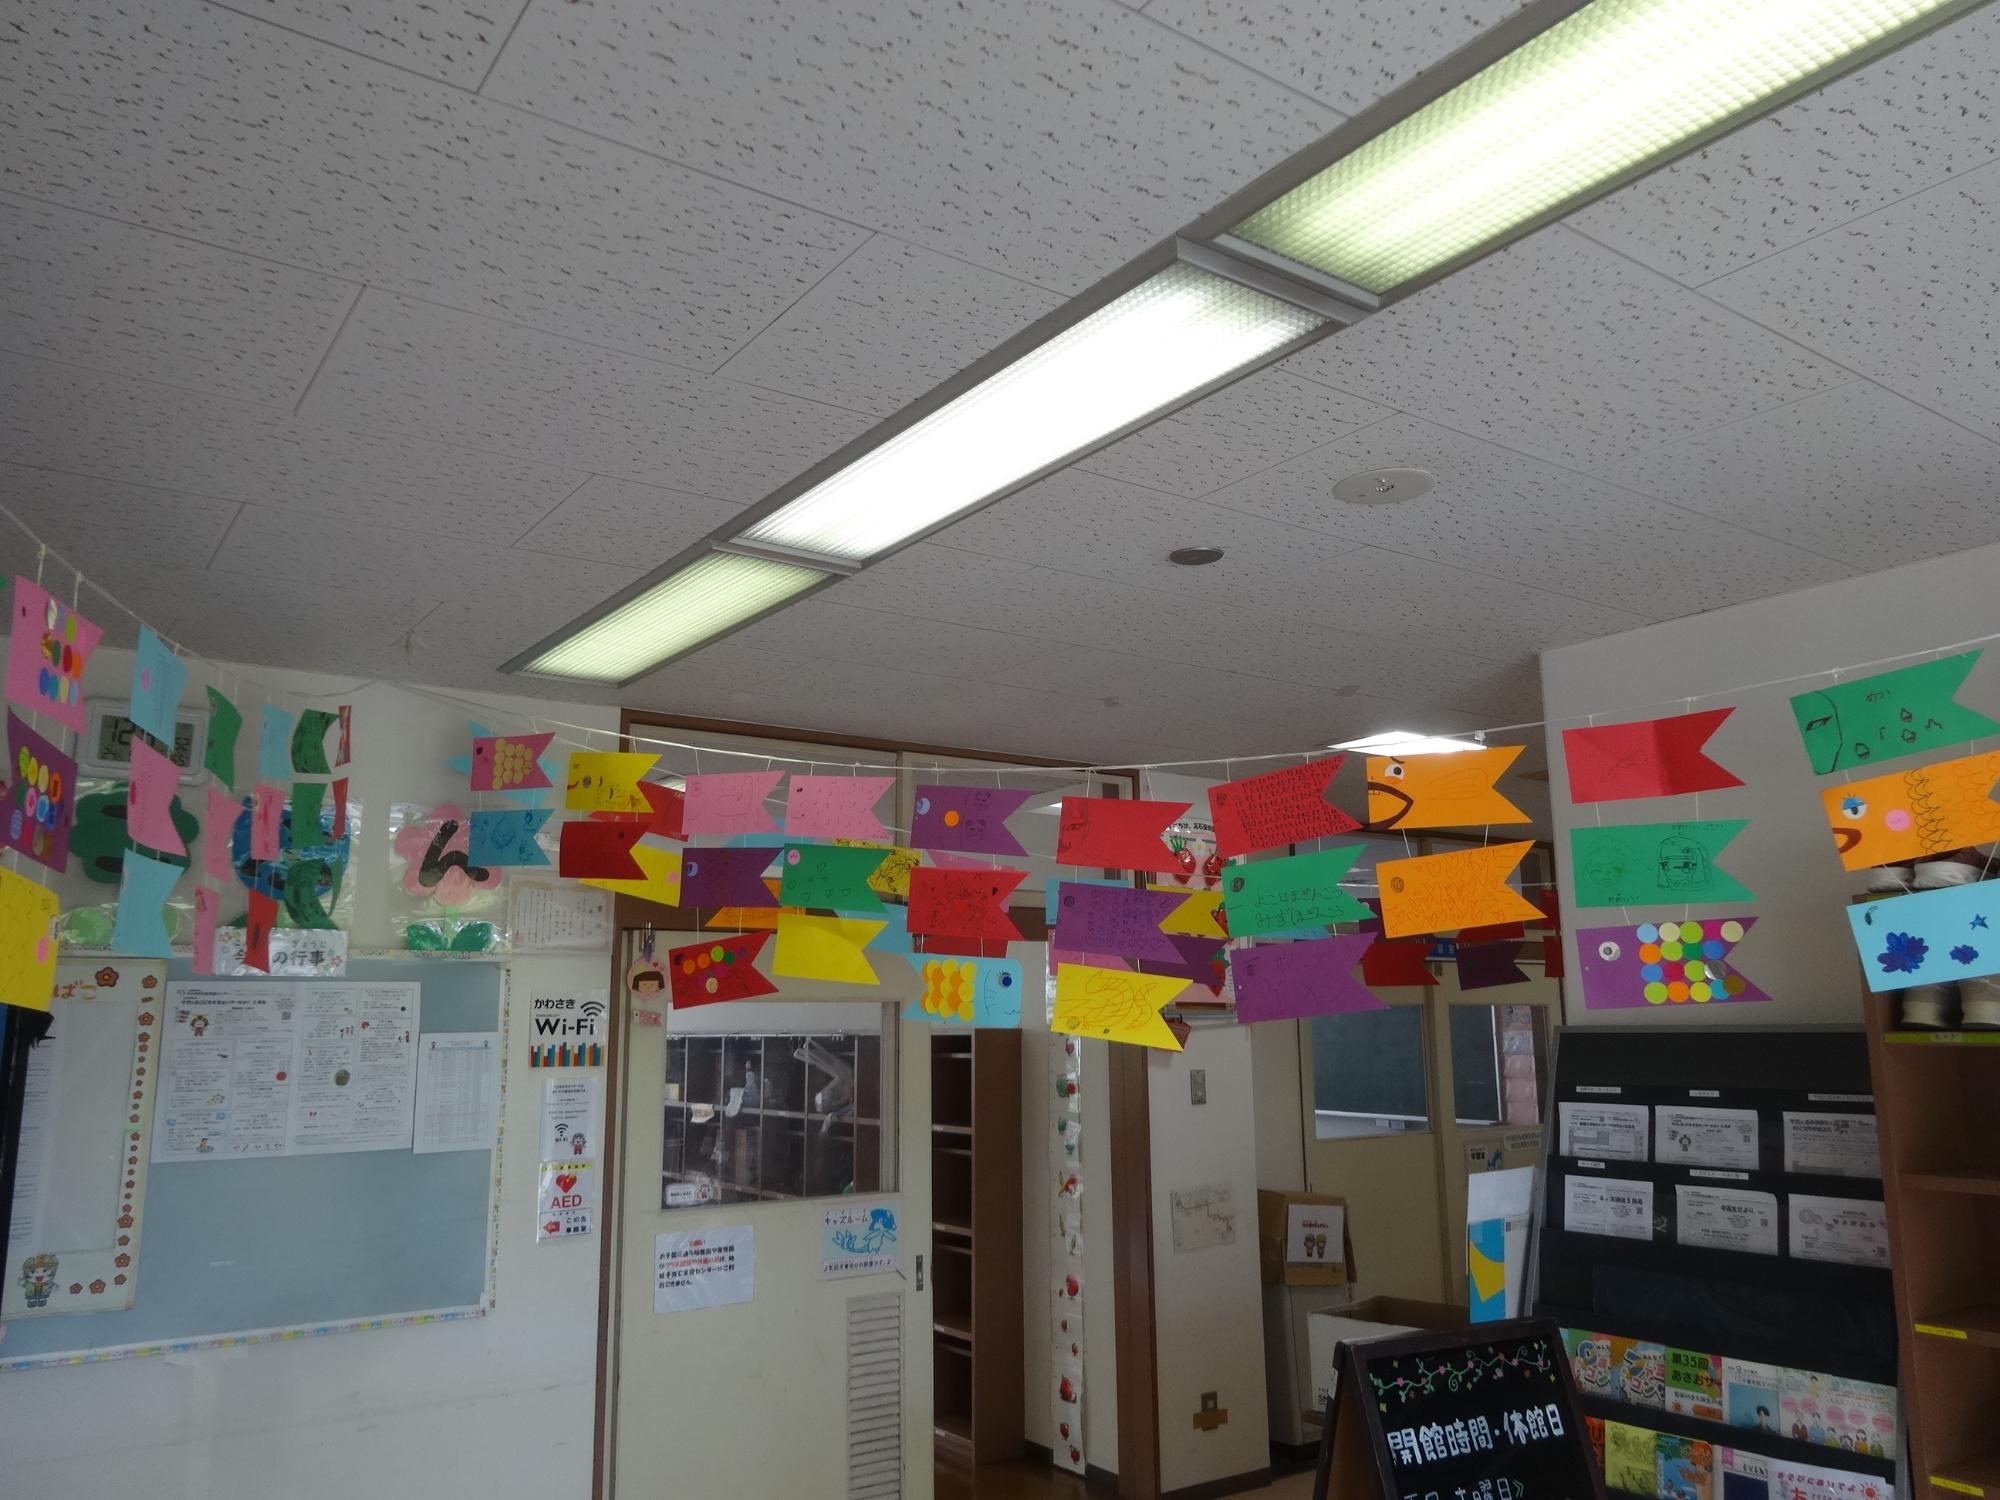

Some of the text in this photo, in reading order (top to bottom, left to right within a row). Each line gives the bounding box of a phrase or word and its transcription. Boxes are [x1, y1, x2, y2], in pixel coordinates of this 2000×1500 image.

[534, 998, 576, 1010] かわさき
[535, 1018, 595, 1036] Wi-Fi
[551, 1194, 582, 1210] AED
[1672, 1352, 1710, 1370] 第35回
[1387, 1403, 1566, 1465] 開館時間・休館日
